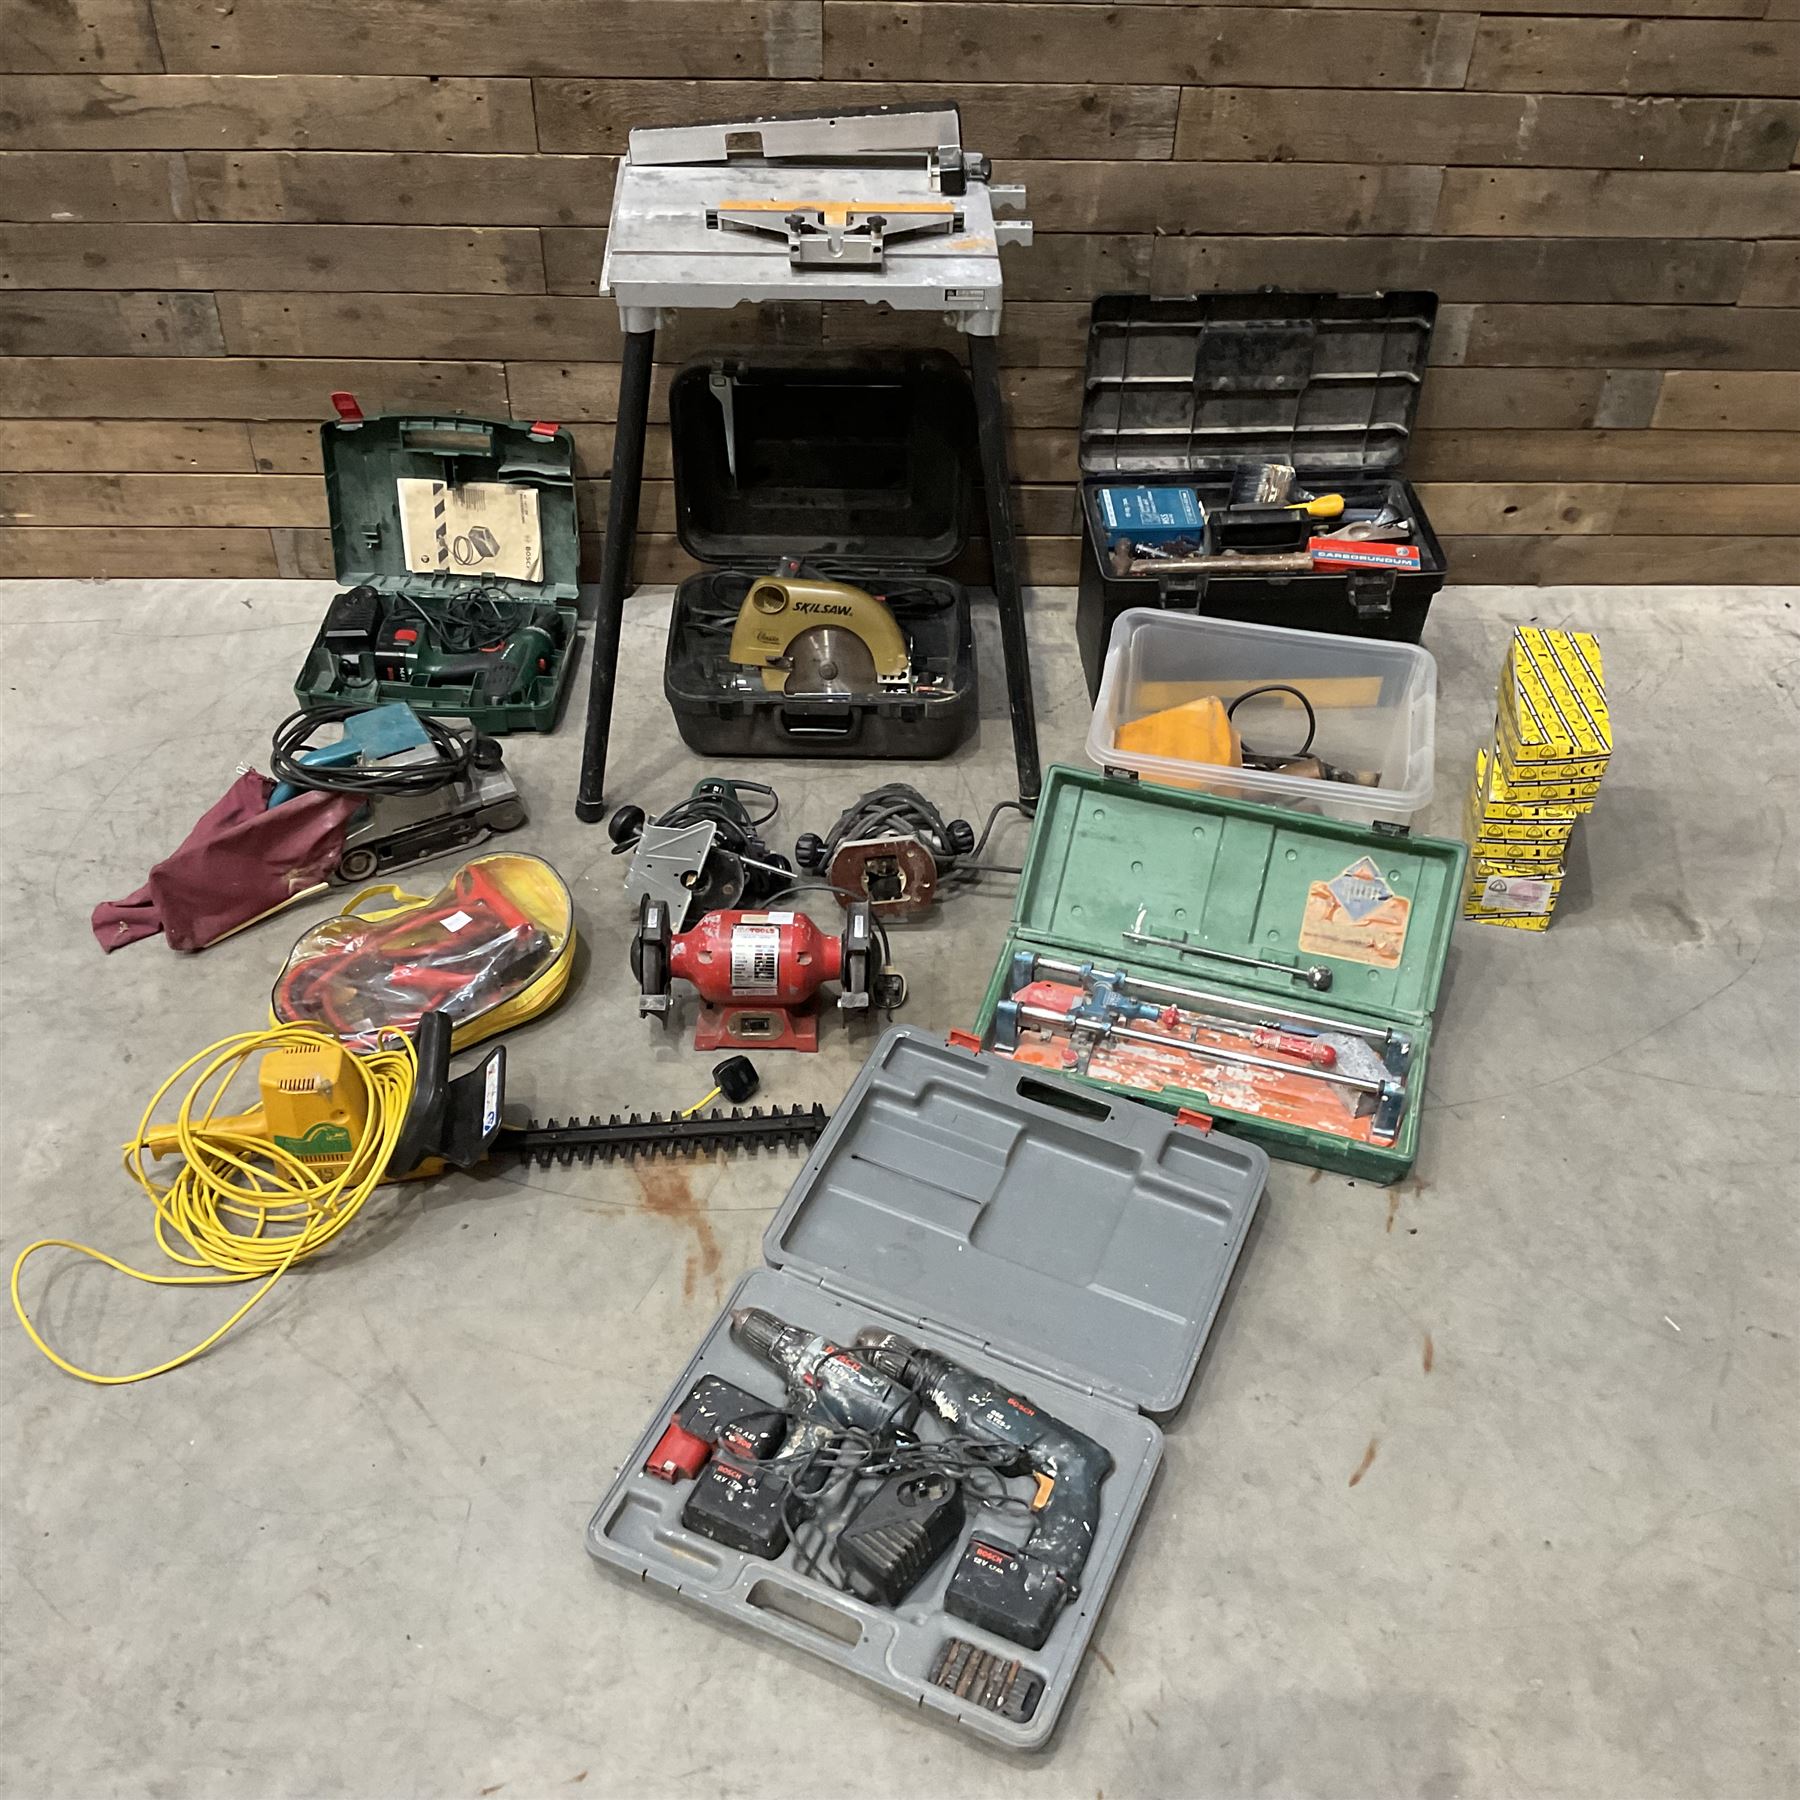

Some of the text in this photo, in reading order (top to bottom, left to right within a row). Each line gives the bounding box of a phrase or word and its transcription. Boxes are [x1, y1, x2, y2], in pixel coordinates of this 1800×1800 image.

[1317, 550, 1413, 567] CARBORUNDUM
[792, 601, 852, 616] SKILSAW
[1007, 1397, 1036, 1417] BOSCH
[717, 1464, 742, 1480] BOSCH
[976, 1548, 1003, 1564] BOSCH
